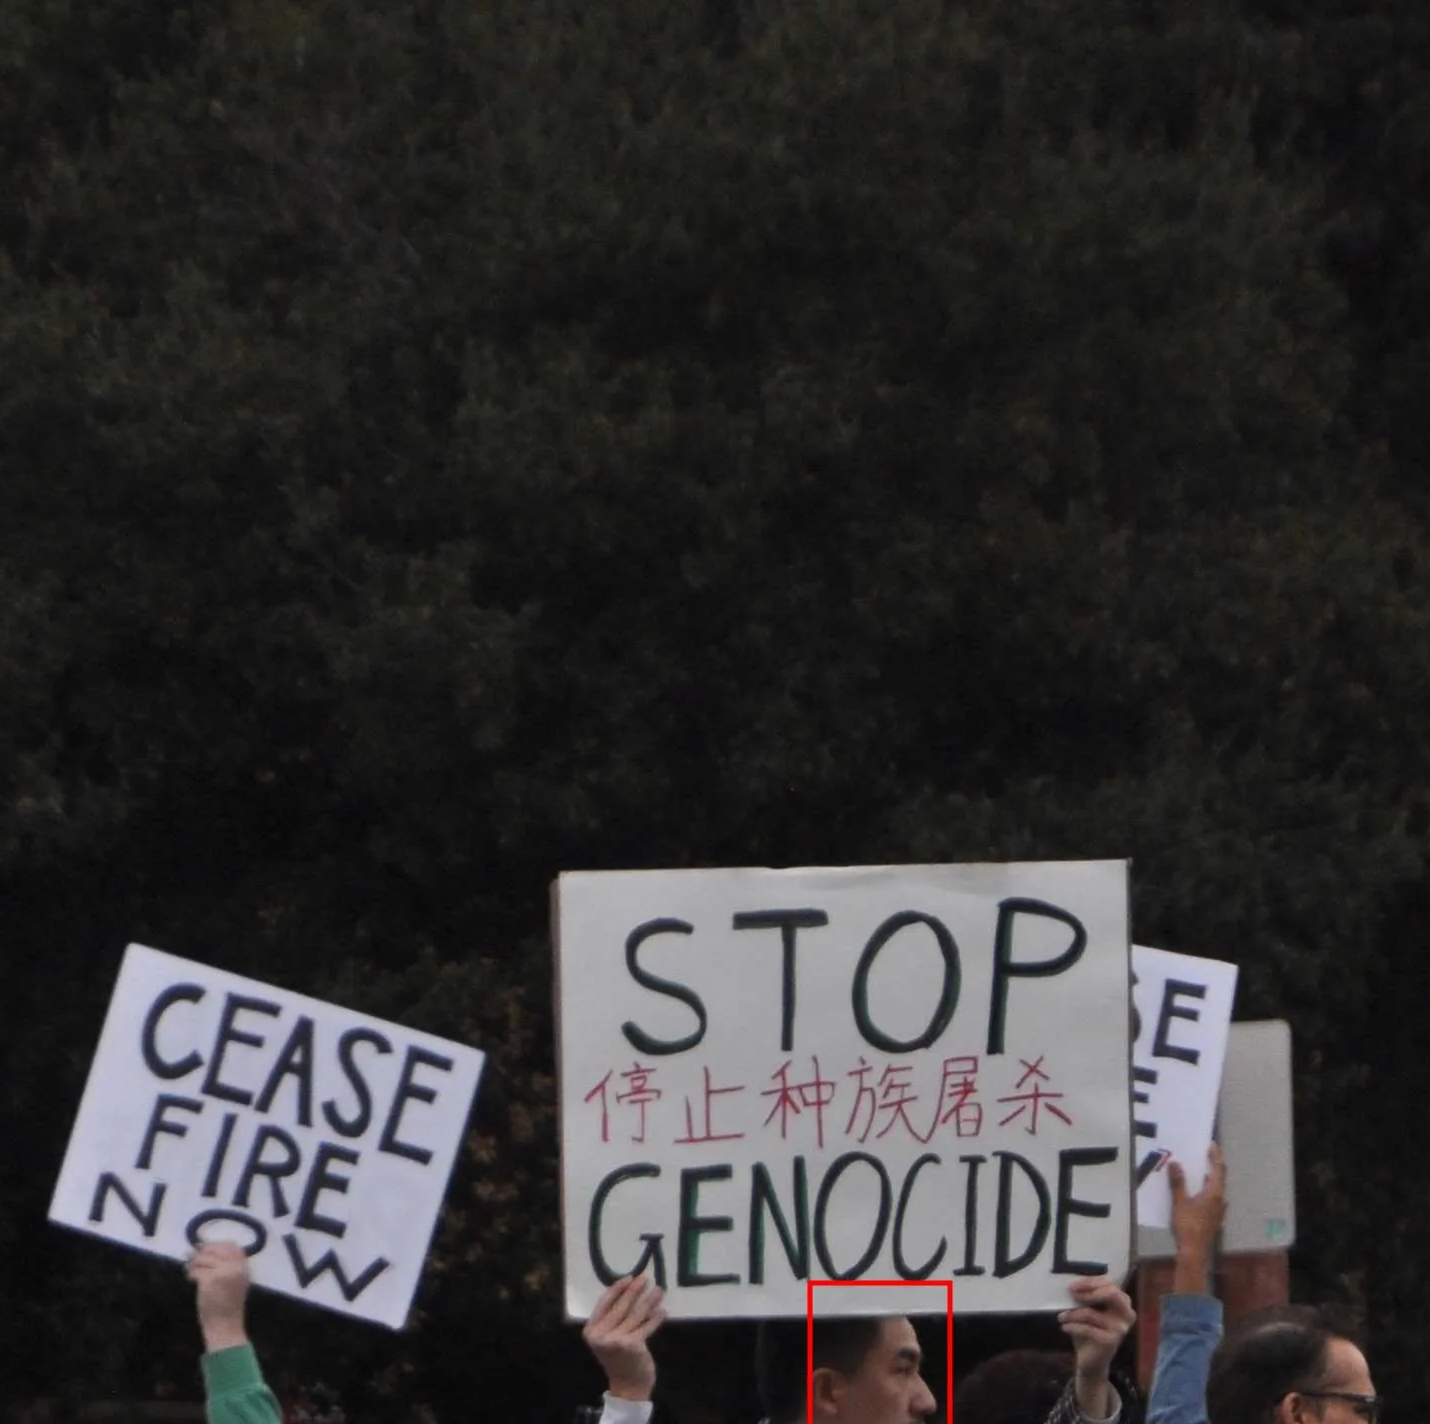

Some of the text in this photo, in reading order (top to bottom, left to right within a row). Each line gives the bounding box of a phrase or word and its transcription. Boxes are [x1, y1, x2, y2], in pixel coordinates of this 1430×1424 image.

[620, 896, 1088, 1056] STOP
[1129, 969, 1208, 1067] E
[140, 981, 455, 1166] CEASE
[583, 1054, 1073, 1148] 停止种族屠杀
[87, 1171, 391, 1303] NOW
[133, 1093, 362, 1239] FIRE
[586, 1146, 1120, 1291] GENOCIDE
